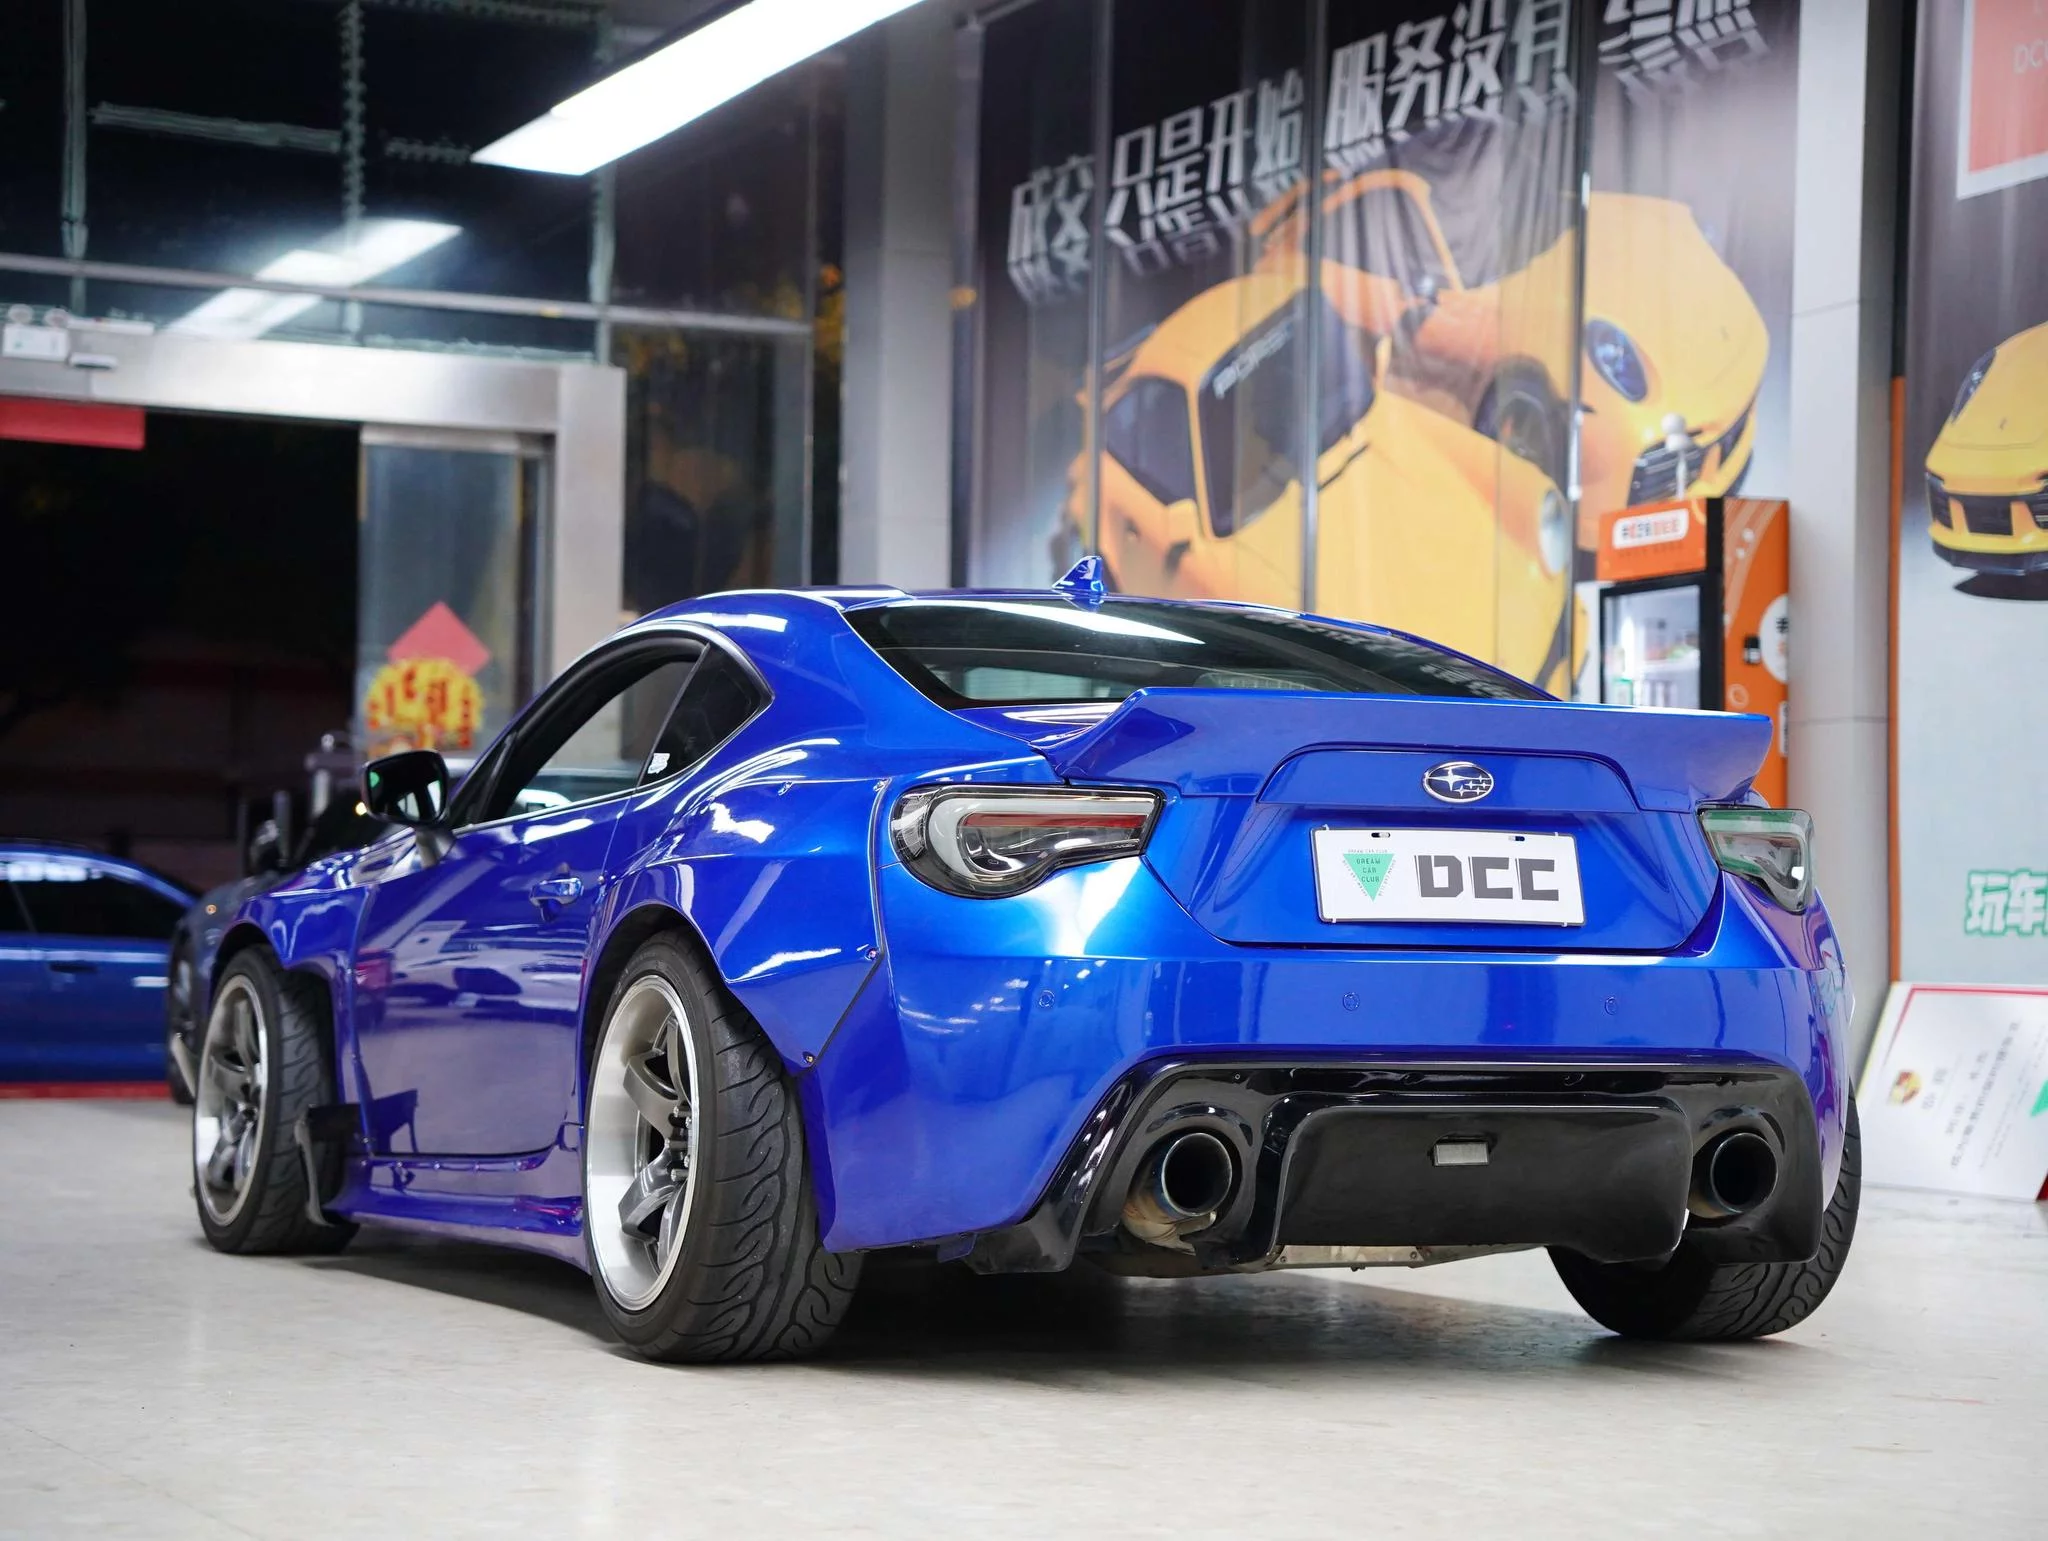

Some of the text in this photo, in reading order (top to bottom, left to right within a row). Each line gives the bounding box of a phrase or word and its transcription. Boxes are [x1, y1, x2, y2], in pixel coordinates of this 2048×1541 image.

[2013, 39, 2048, 75] DC
[1414, 855, 1559, 902] DCC
[1964, 867, 2048, 936] 玩车
